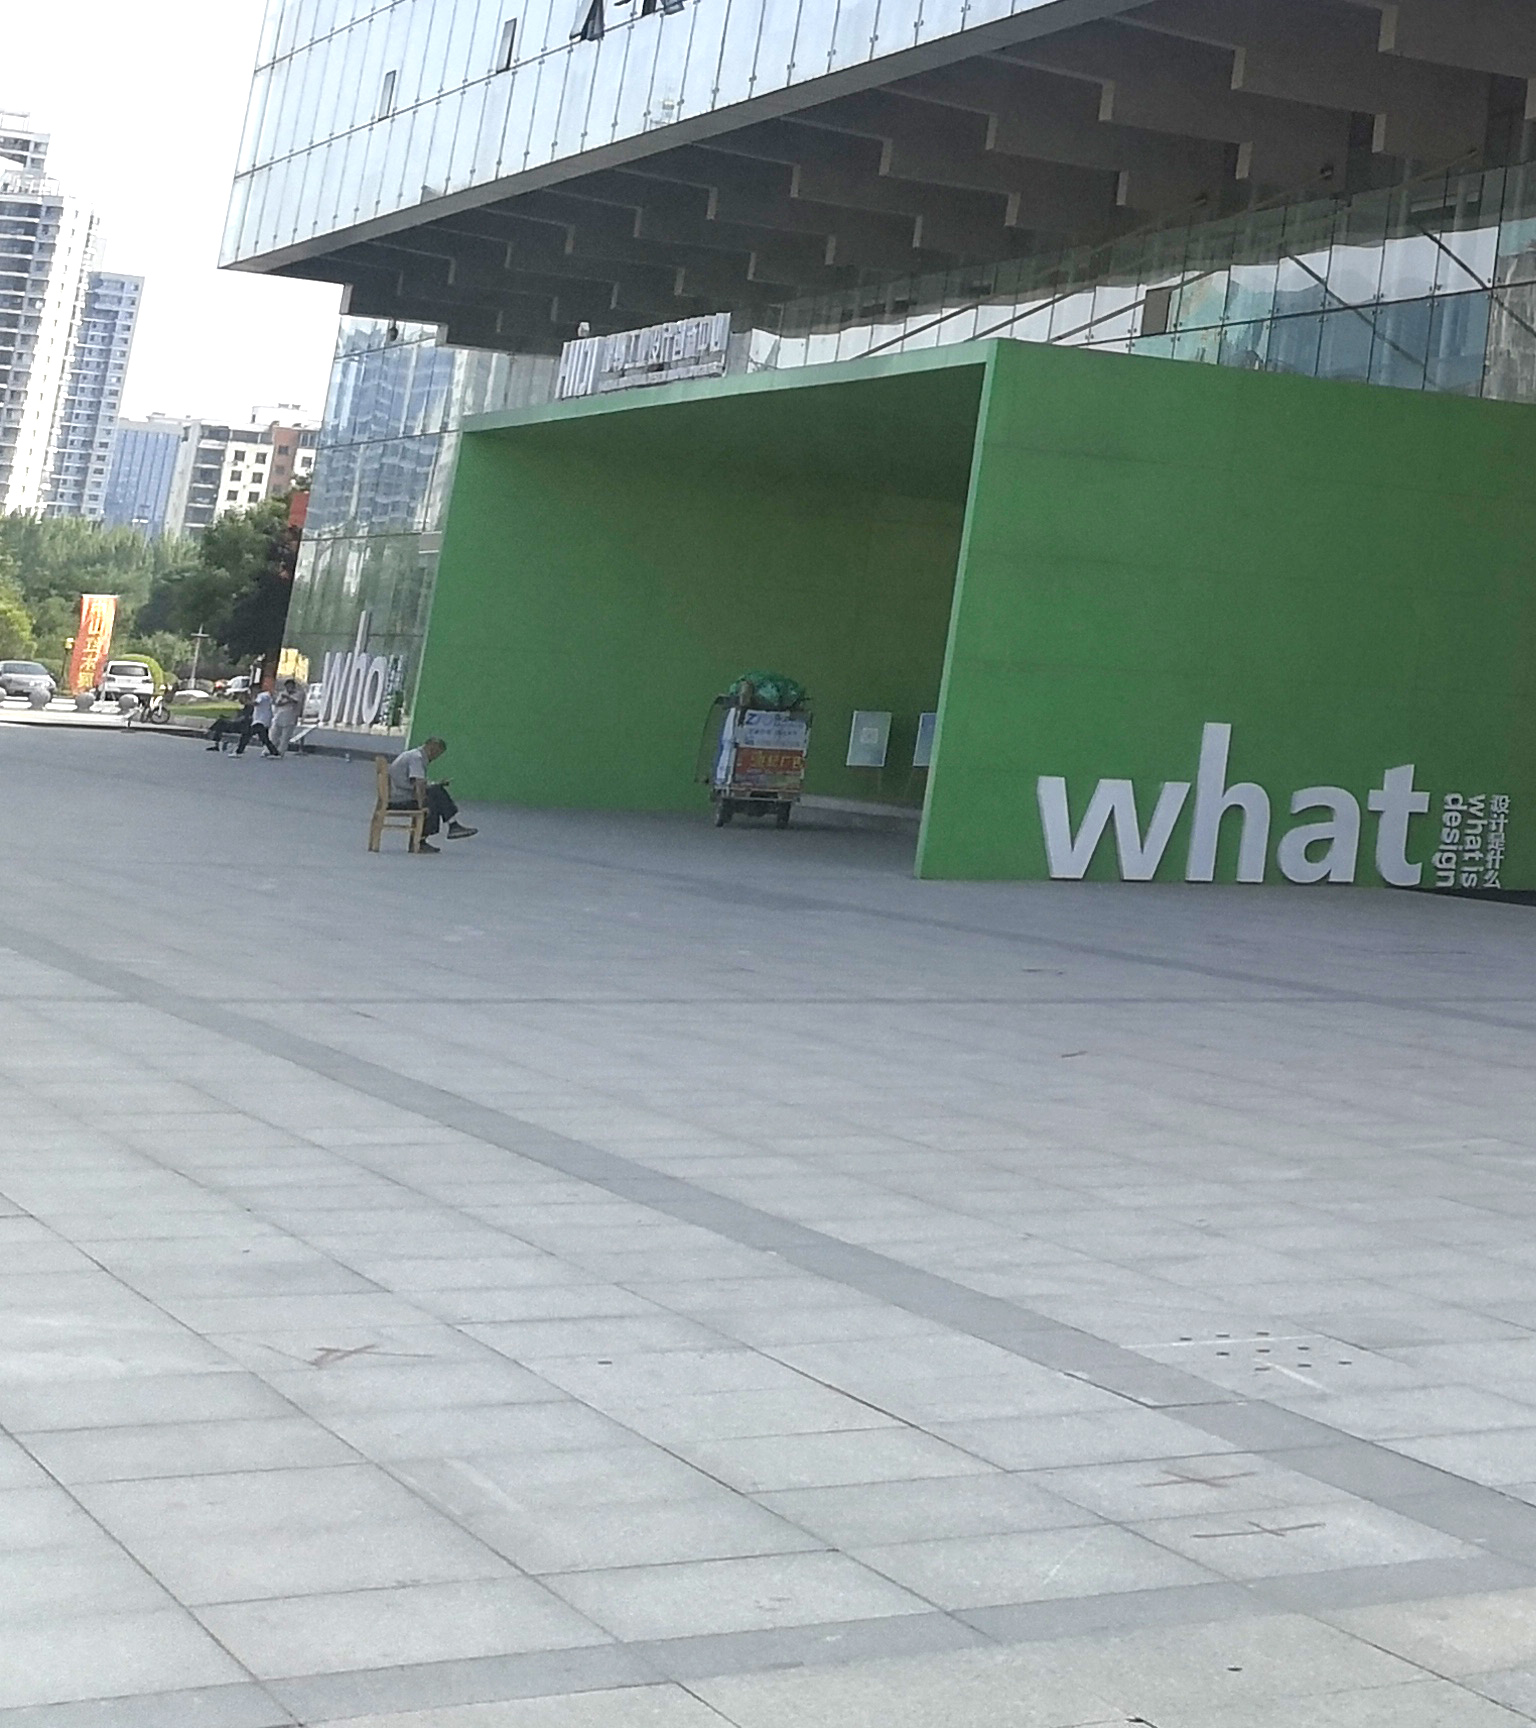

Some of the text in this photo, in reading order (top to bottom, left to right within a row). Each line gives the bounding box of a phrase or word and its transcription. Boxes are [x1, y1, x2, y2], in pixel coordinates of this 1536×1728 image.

[1036, 722, 1430, 887] what
[1431, 793, 1468, 887] design
[1461, 794, 1488, 888] what is
